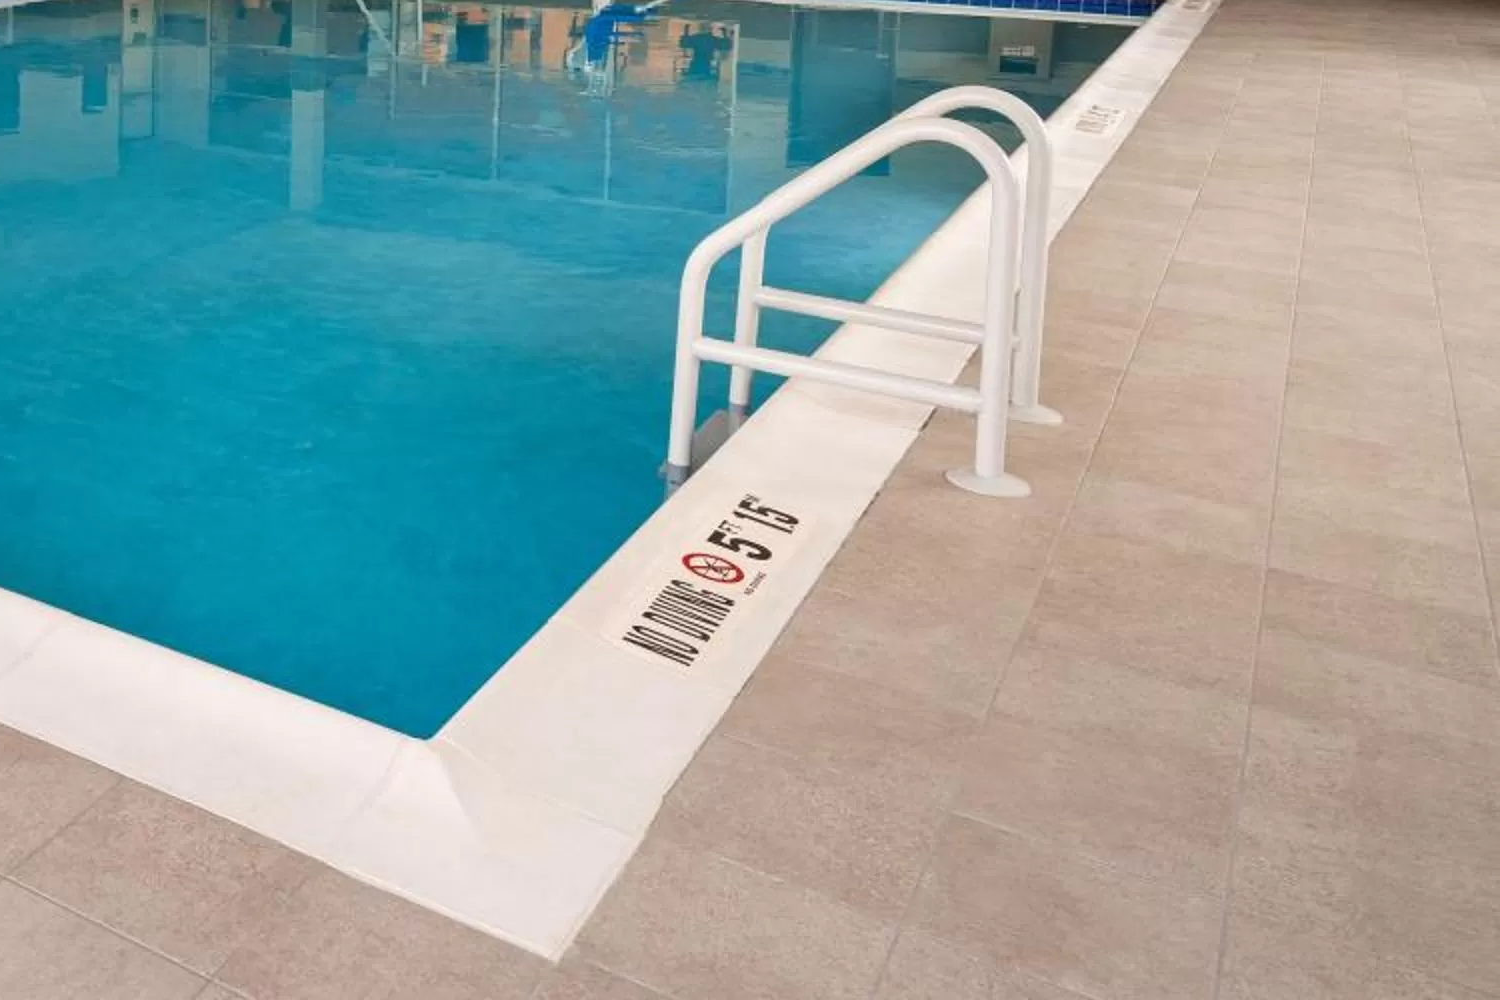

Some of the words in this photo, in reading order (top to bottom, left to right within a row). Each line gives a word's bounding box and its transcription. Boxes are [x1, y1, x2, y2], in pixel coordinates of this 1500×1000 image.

[706, 529, 772, 561] 5
[641, 579, 736, 642] DIVING
[622, 624, 700, 667] NO
